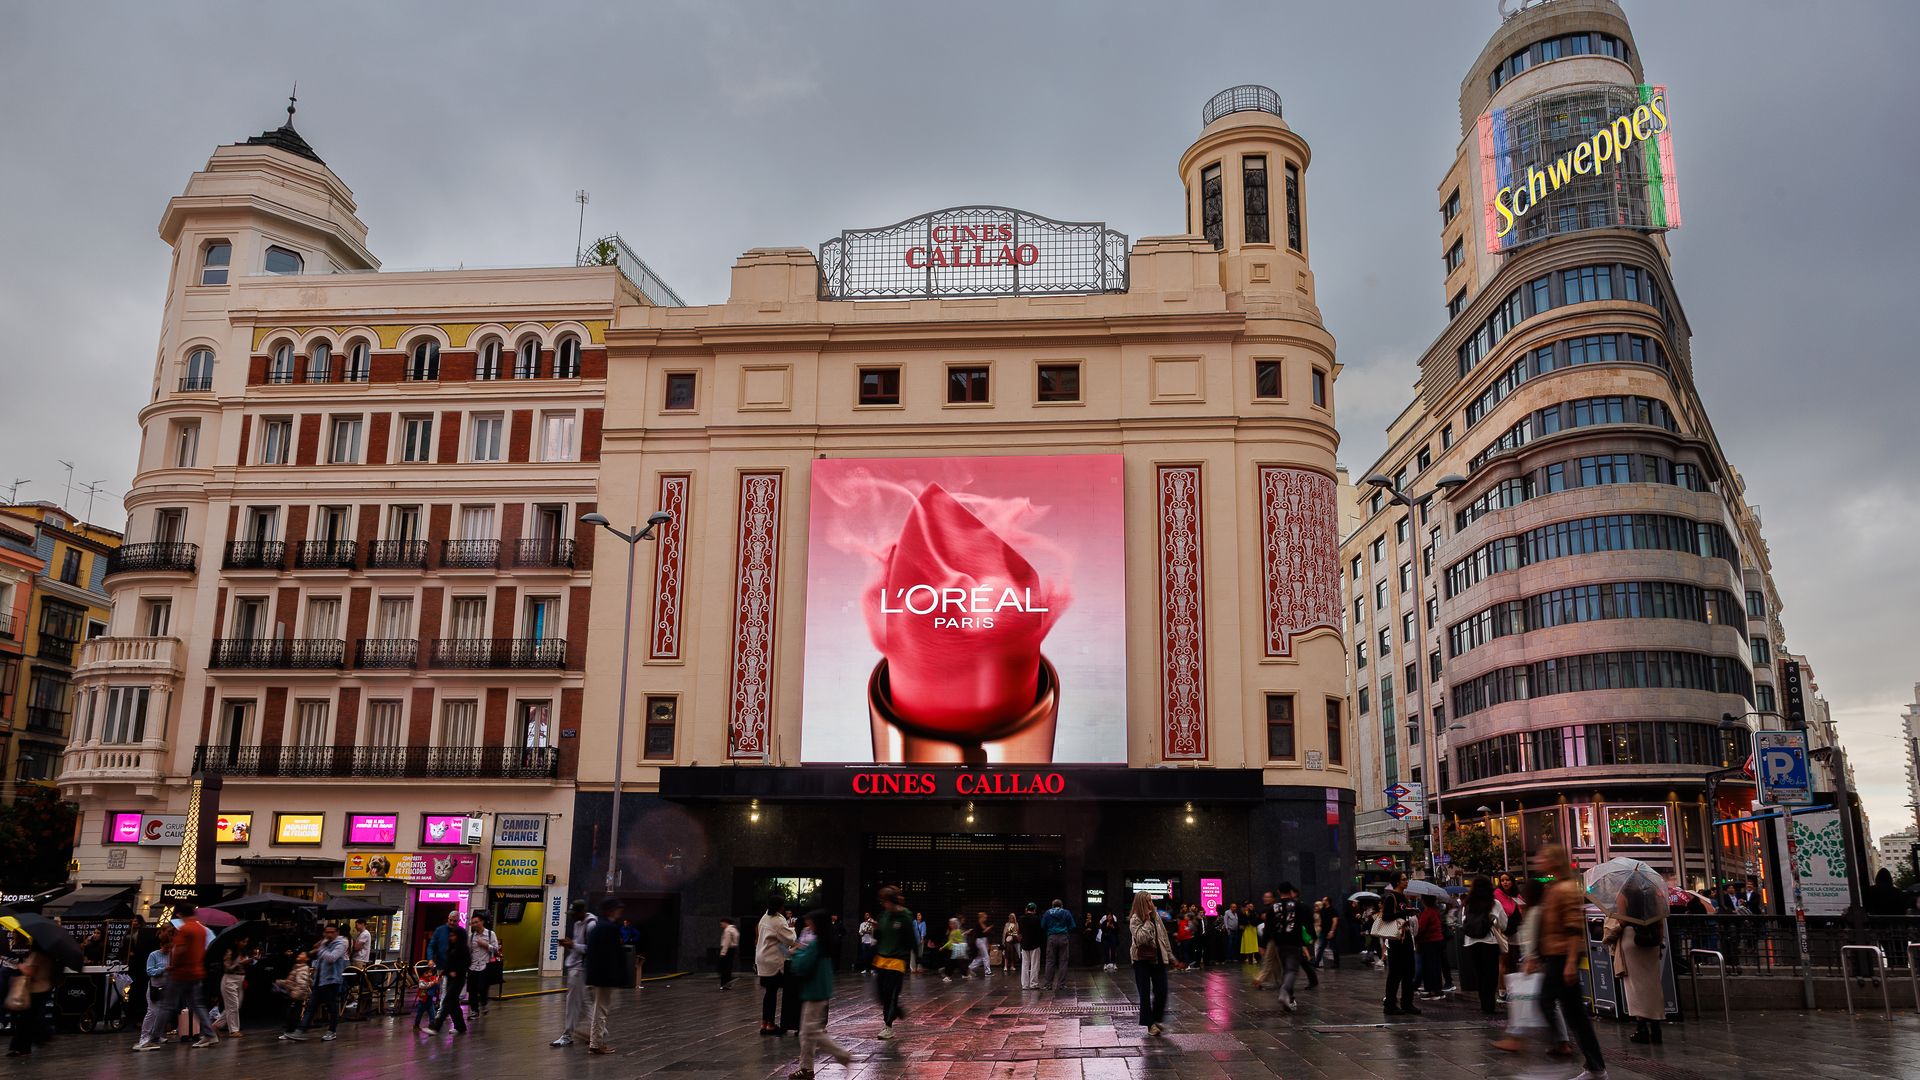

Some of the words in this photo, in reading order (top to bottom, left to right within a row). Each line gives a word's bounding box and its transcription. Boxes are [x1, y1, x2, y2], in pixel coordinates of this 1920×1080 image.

[1495, 95, 1668, 238] Schweppes
[932, 223, 1013, 243] CINES
[905, 243, 1039, 269] CALLAO
[880, 584, 1048, 615] L'ORÉAL
[1767, 752, 1794, 784] P
[852, 773, 936, 794] CINES
[956, 773, 1065, 794] CALLAO
[502, 819, 540, 830] CAMBIO
[501, 831, 538, 842] CHANGE
[495, 868, 539, 876] CHANGE
[497, 859, 538, 867] CAMBIO
[551, 896, 562, 926] CHANGE
[549, 930, 559, 961] CAMBIO
